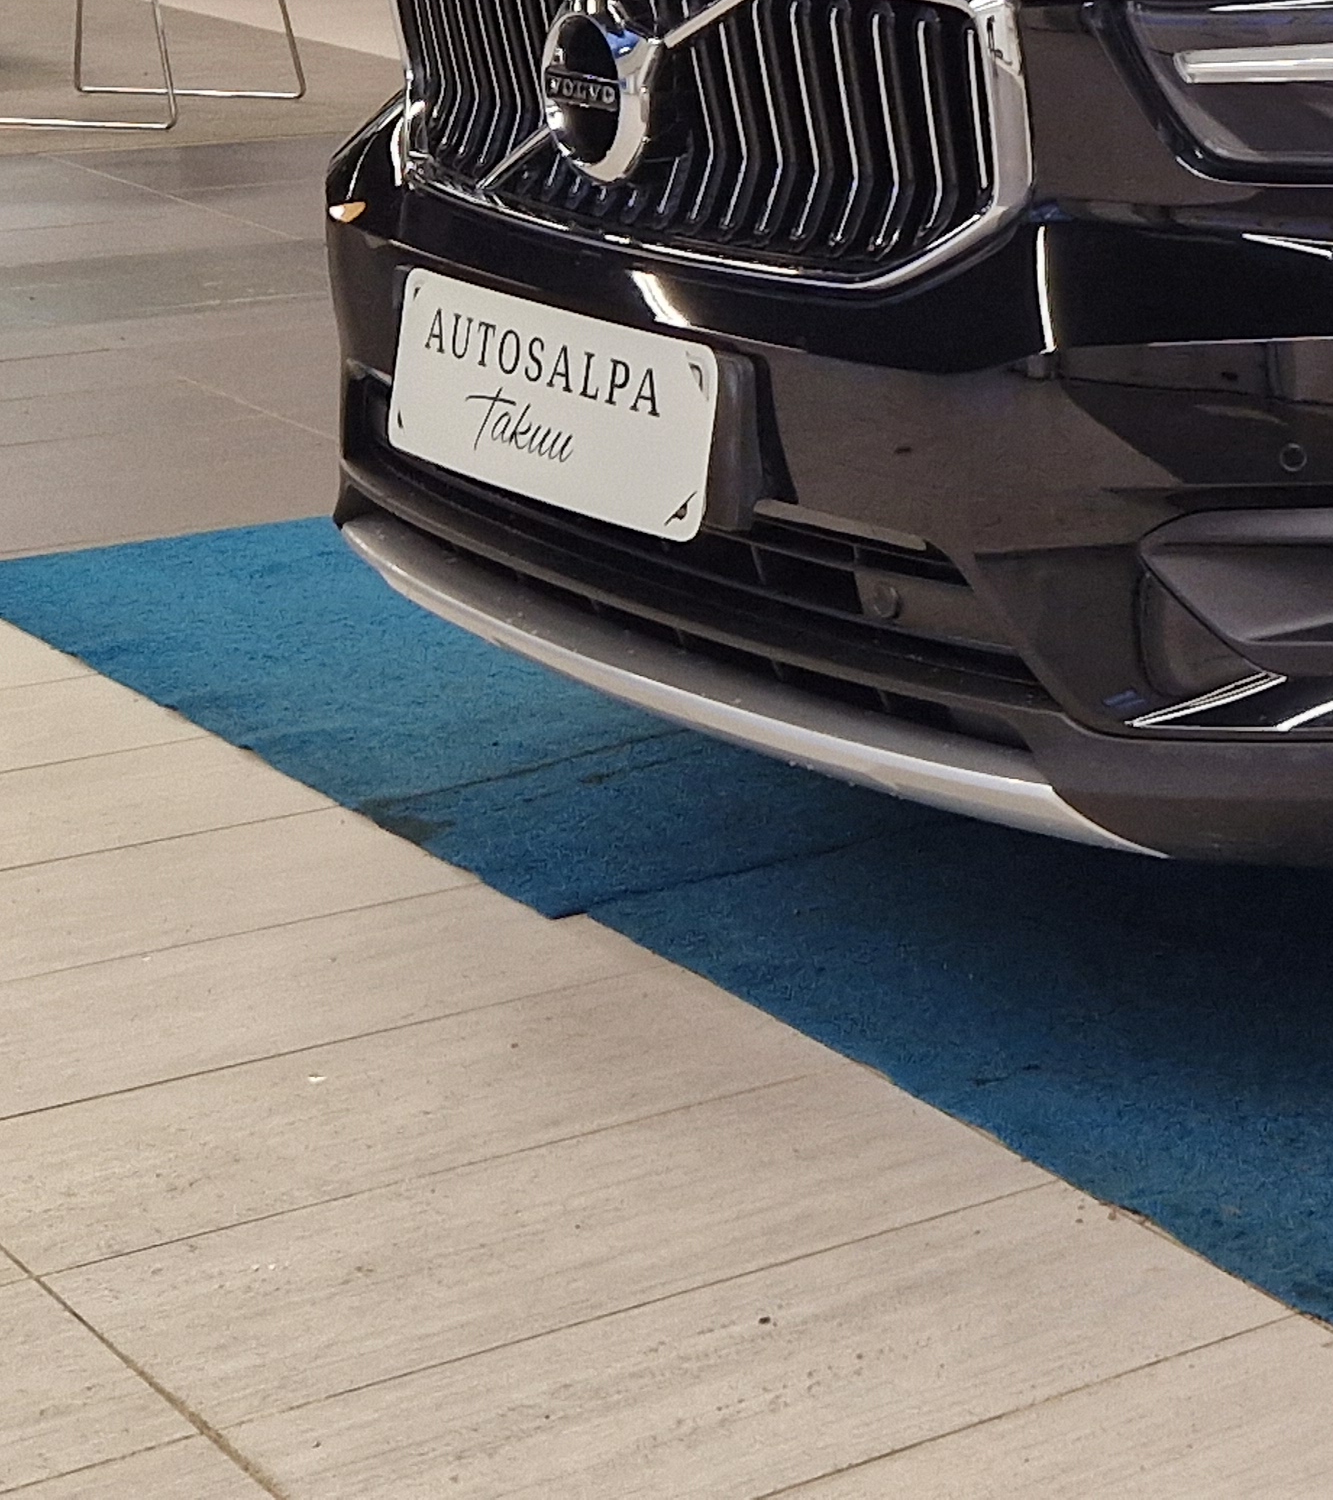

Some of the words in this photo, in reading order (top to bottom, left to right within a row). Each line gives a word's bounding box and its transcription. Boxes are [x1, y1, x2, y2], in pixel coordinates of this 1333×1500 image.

[547, 76, 616, 104] VOLVO
[424, 307, 661, 417] AUTOSALPA
[465, 386, 574, 463] Takuu
